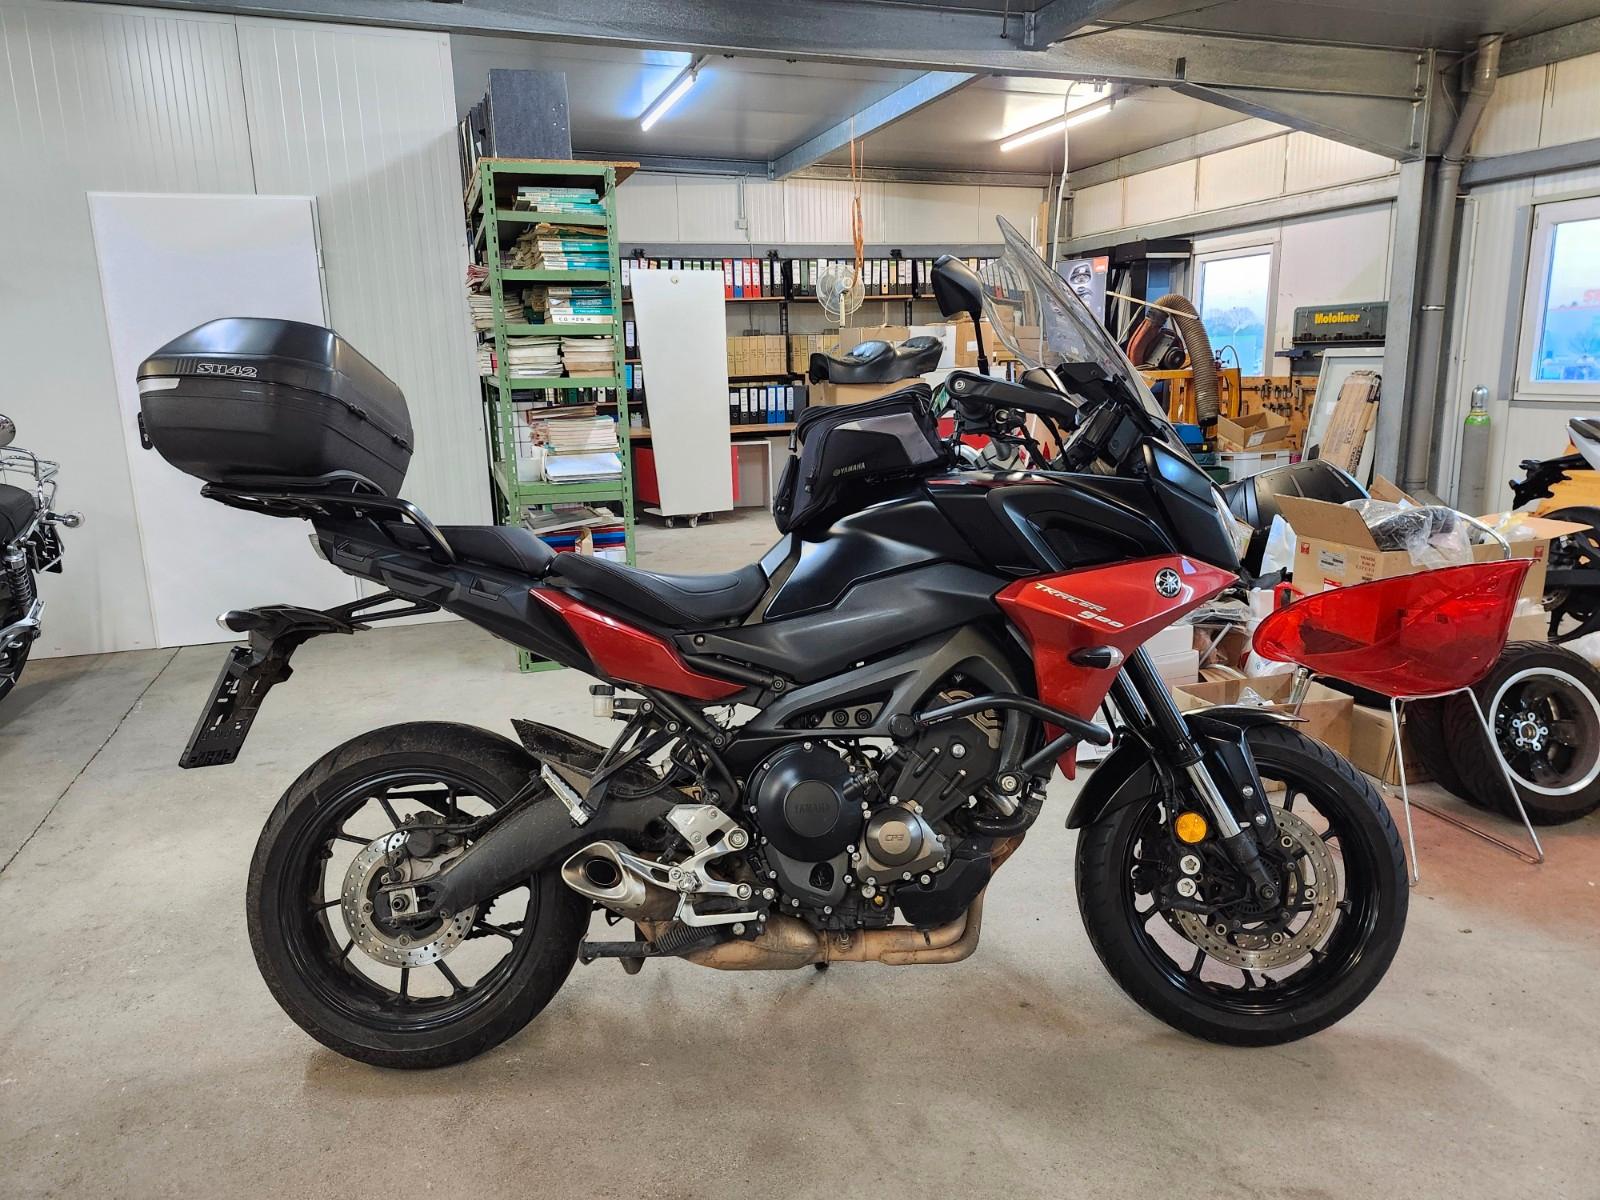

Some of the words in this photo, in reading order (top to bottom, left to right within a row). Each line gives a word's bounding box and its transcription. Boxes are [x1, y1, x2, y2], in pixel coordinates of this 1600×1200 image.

[1314, 311, 1361, 325] Motoliner
[196, 363, 258, 378] SH42
[840, 461, 866, 475] YAMAHA
[1034, 582, 1107, 612] TRACER
[1077, 610, 1125, 628] 900
